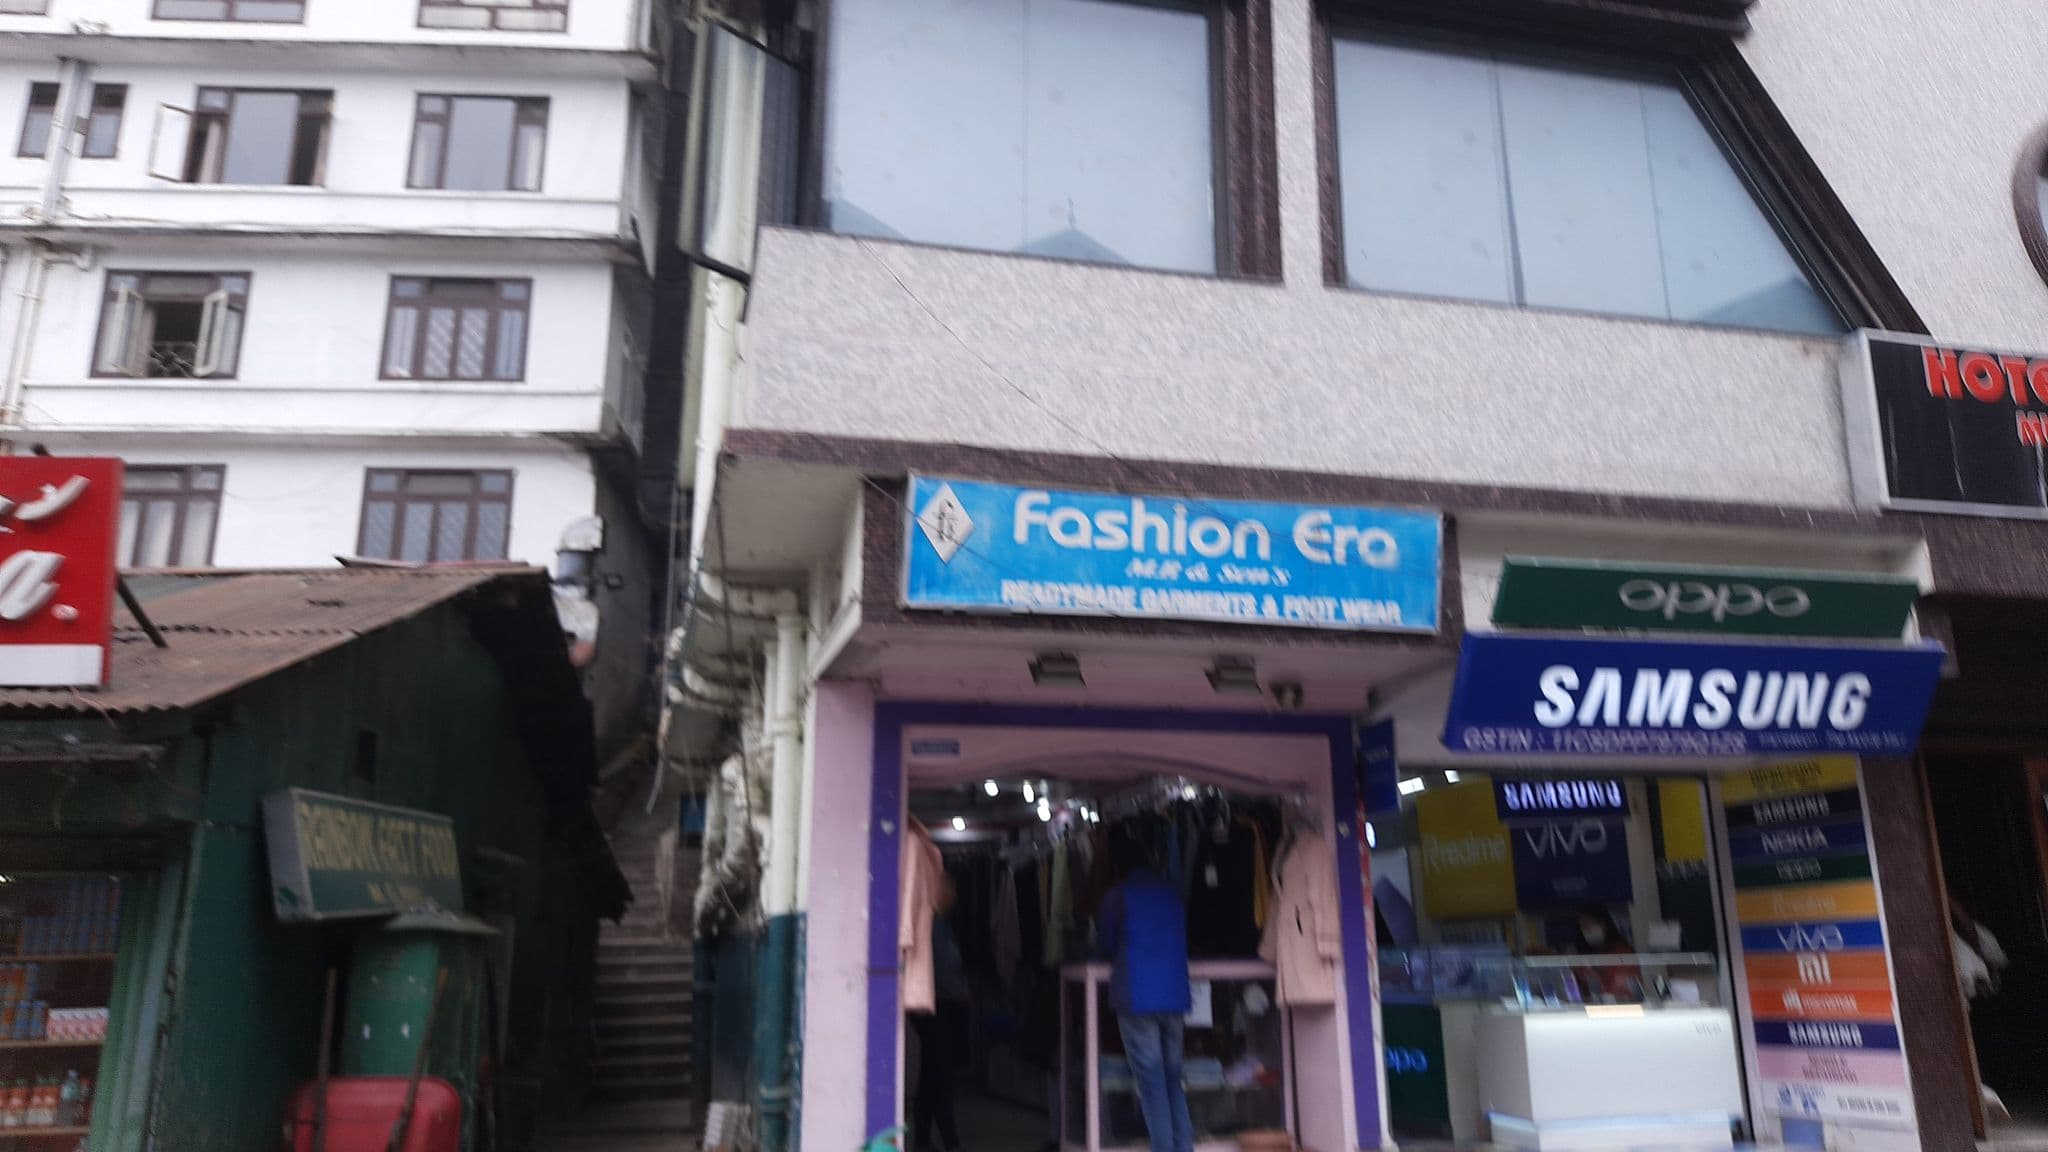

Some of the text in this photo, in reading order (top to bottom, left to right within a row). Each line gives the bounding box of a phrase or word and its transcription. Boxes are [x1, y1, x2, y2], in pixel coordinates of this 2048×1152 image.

[1013, 490, 1271, 561] Fashion
[1294, 510, 1400, 569] Era
[1001, 579, 1402, 625] READYMADE GARMENTS & FOOT WEAR
[1618, 579, 1811, 622] oppo
[1534, 664, 1872, 731] SAMSUNG
[1463, 727, 1533, 752] GSTIN
[1504, 780, 1623, 810] SAMSUNG
[1753, 793, 1830, 825] SAMSUNG
[1761, 825, 1829, 855] NOKIA
[1787, 1021, 1864, 1047] SAMSUNG
